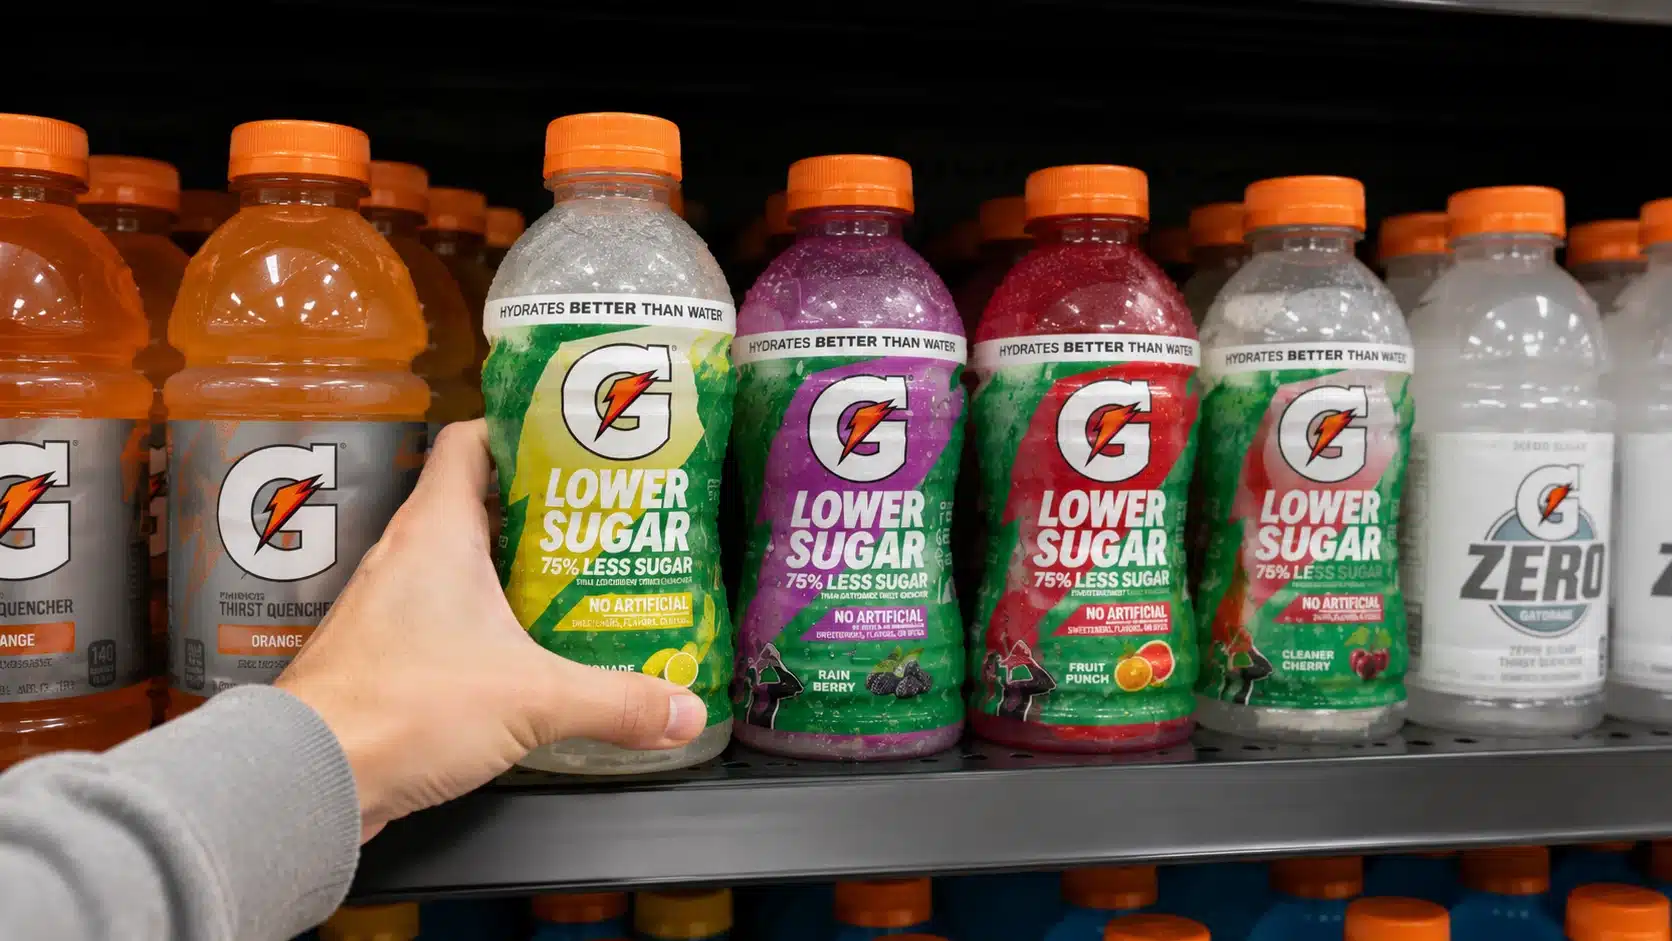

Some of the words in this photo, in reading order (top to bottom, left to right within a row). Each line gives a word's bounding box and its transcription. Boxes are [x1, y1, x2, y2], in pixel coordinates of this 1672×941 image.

[500, 302, 565, 318] HYDRATES
[570, 301, 636, 315] BETTER
[642, 302, 683, 317] THAN
[688, 305, 723, 321] WATER
[749, 337, 810, 353] HYDRATES
[815, 335, 877, 348] BETTER
[882, 336, 920, 348] THAN
[923, 338, 956, 352] WATER
[999, 342, 1059, 357] HYDRATES
[1063, 341, 1124, 353] BETTER
[1128, 342, 1162, 354] THAN
[1166, 344, 1193, 356] WATER
[1225, 351, 1283, 365] HYDRATES
[1287, 350, 1343, 361] BETTER
[1347, 350, 1379, 361] THAN
[561, 342, 672, 461] G
[808, 374, 908, 483] G
[1056, 379, 1152, 483] G
[1278, 385, 1368, 483] G
[545, 468, 689, 509] LOWER
[790, 490, 925, 528] LOWER
[1038, 489, 1166, 528] LOWER
[1259, 489, 1381, 525] LOWER
[1515, 463, 1580, 542] G
[217, 443, 338, 582] G
[539, 510, 690, 553] SUGAR
[786, 530, 926, 570] SUGAR
[1033, 529, 1168, 568] SUGAR
[1255, 525, 1382, 562] SUGAR
[541, 556, 580, 575] 75%
[583, 557, 630, 576] LESS
[634, 556, 693, 575] SUGAR
[1256, 564, 1290, 580] 75%
[1293, 564, 1335, 580] LESS
[1338, 564, 1383, 580] SUGAR
[1459, 543, 1605, 601] ZERO
[786, 572, 823, 590] 75%
[827, 572, 872, 590] LESS
[875, 572, 928, 590] SUGAR
[1034, 571, 1071, 588] 75%
[1075, 571, 1118, 588] LESS
[1121, 570, 1169, 587] SUGAR
[220, 601, 263, 617] THIRST
[267, 601, 334, 618] QUENCHE
[589, 597, 611, 613] NO
[614, 595, 689, 612] ARTIFICIAL
[1302, 597, 1320, 610] NO
[1322, 596, 1380, 610] ARTIFICIAL
[834, 610, 854, 623] NO
[857, 609, 923, 624] ARTIFICIAL
[1086, 606, 1105, 620] NO
[1107, 605, 1168, 621] ARTIFICIAL
[252, 634, 303, 648] ORANGE
[92, 644, 114, 664] 140
[1282, 650, 1335, 660] CLEANER
[818, 670, 850, 680] RAIN
[1069, 662, 1106, 672] FRUIT
[1282, 661, 1331, 671] CHERRY
[813, 682, 855, 692] BERRY
[1066, 674, 1110, 685] PUNCH
